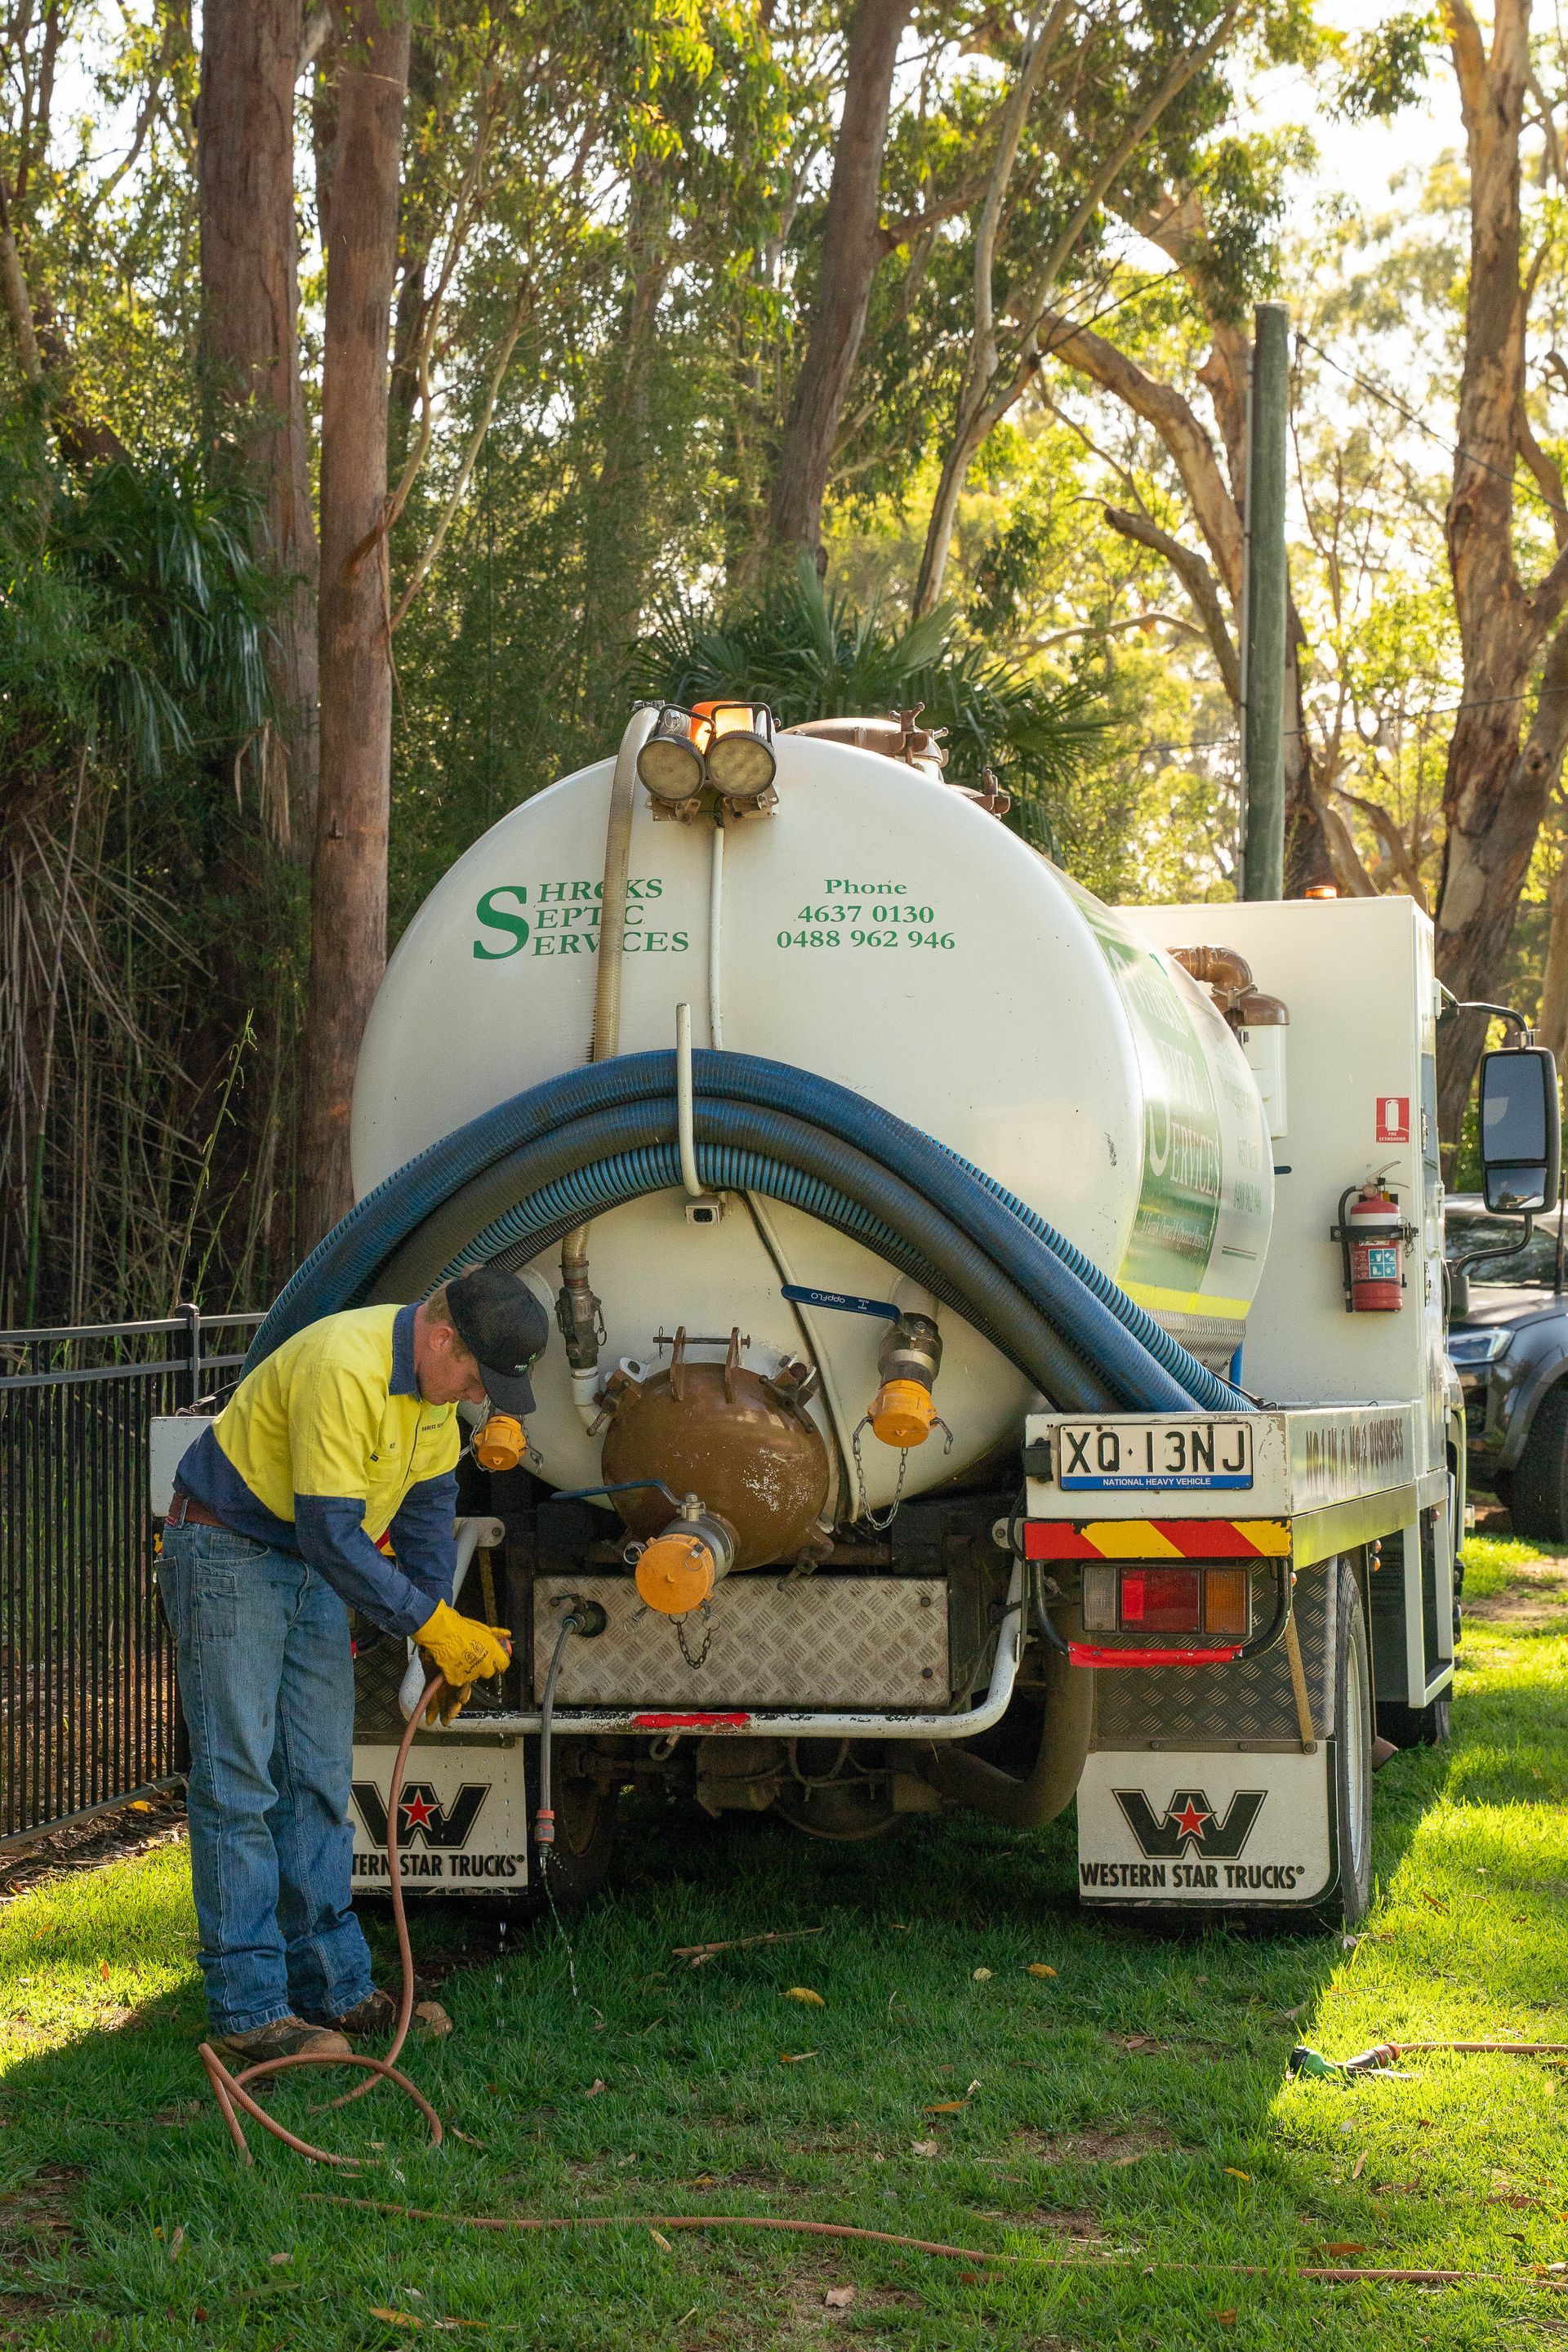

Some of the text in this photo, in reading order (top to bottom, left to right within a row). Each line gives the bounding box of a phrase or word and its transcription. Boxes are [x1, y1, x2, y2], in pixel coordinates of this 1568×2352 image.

[824, 879, 907, 895] Phone
[533, 905, 644, 929] EPTC
[797, 906, 934, 924] 4637 0130
[531, 931, 690, 956] ERVCES
[777, 930, 956, 949] 0488 962 946
[1102, 1477, 1211, 1486] NATIONAL HEAVY VEHICLE
[399, 1854, 443, 1877] STAR
[1080, 1863, 1166, 1887] WESTERN
[1172, 1864, 1219, 1888] STAR
